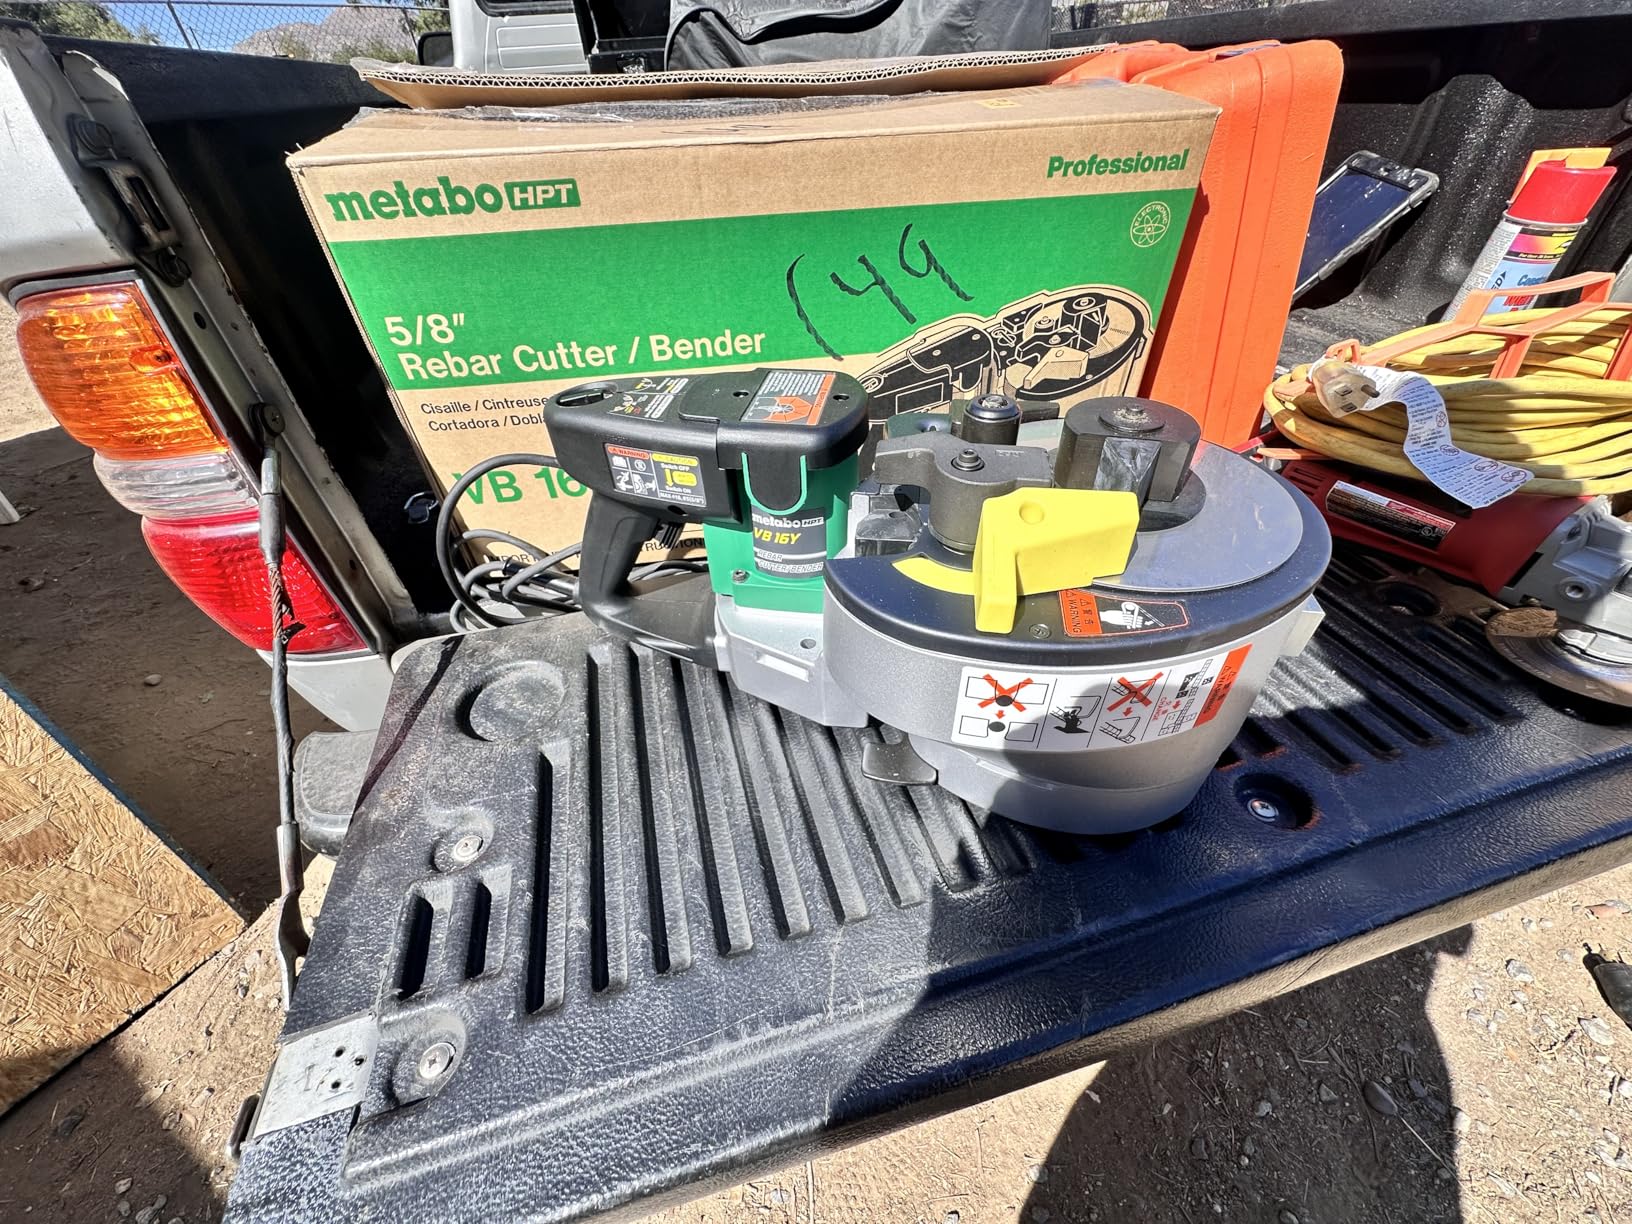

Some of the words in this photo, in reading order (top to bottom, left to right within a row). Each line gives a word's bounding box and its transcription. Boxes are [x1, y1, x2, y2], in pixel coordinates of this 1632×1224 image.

[1047, 148, 1190, 178] Professional
[323, 176, 504, 222] metabo
[508, 181, 577, 208] HPT
[1134, 204, 1169, 227] ELECTRONIC
[384, 313, 465, 347] 5/8"
[399, 350, 503, 380] Rebar
[513, 340, 618, 372] Cutter
[628, 336, 641, 364] /
[648, 329, 766, 362] Bender
[420, 402, 472, 415] Cisaille
[482, 396, 548, 411] Cintreuse
[428, 417, 500, 432] Cortadora
[510, 413, 545, 427] Dobl
[452, 470, 523, 505] VB
[752, 513, 801, 528] metabo
[802, 517, 824, 527] HPT
[753, 526, 772, 542] VB
[774, 532, 802, 544] 16Y
[757, 550, 783, 562] REBAR
[1068, 599, 1082, 634] WARNING
